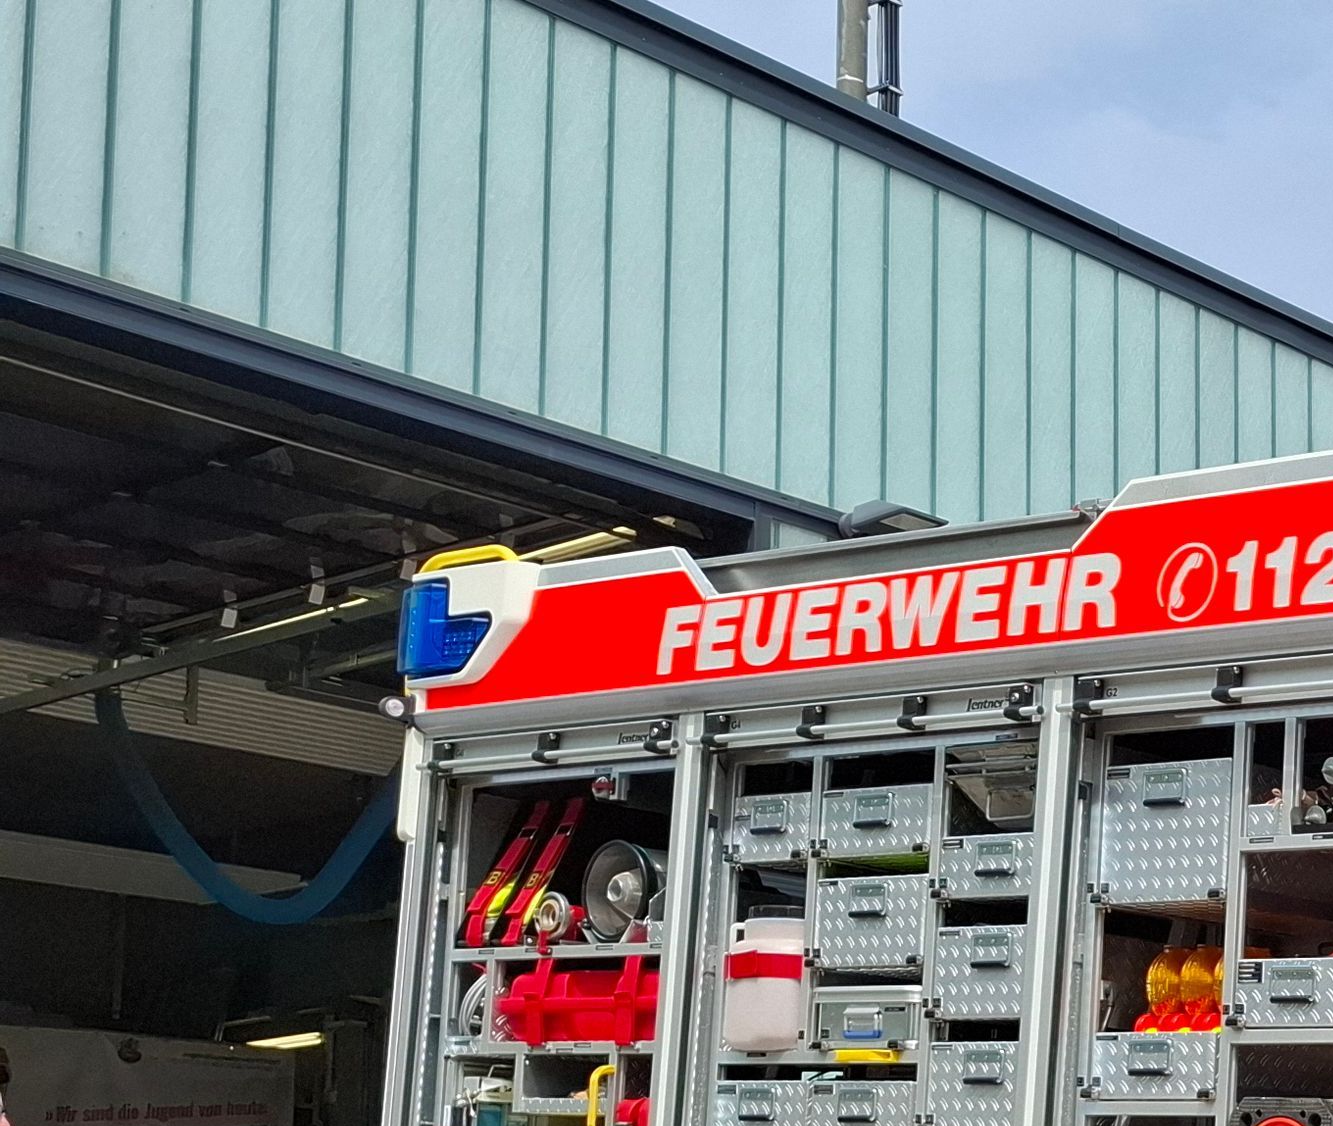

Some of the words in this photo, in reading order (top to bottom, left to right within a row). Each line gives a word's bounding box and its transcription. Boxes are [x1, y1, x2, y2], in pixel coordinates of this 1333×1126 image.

[656, 551, 1122, 676] FEUERWEHR
[1106, 687, 1118, 698] G2
[83, 1103, 114, 1122] sind
[118, 1103, 140, 1121] die
[144, 1101, 194, 1122] Jugend
[198, 1102, 223, 1118] von
